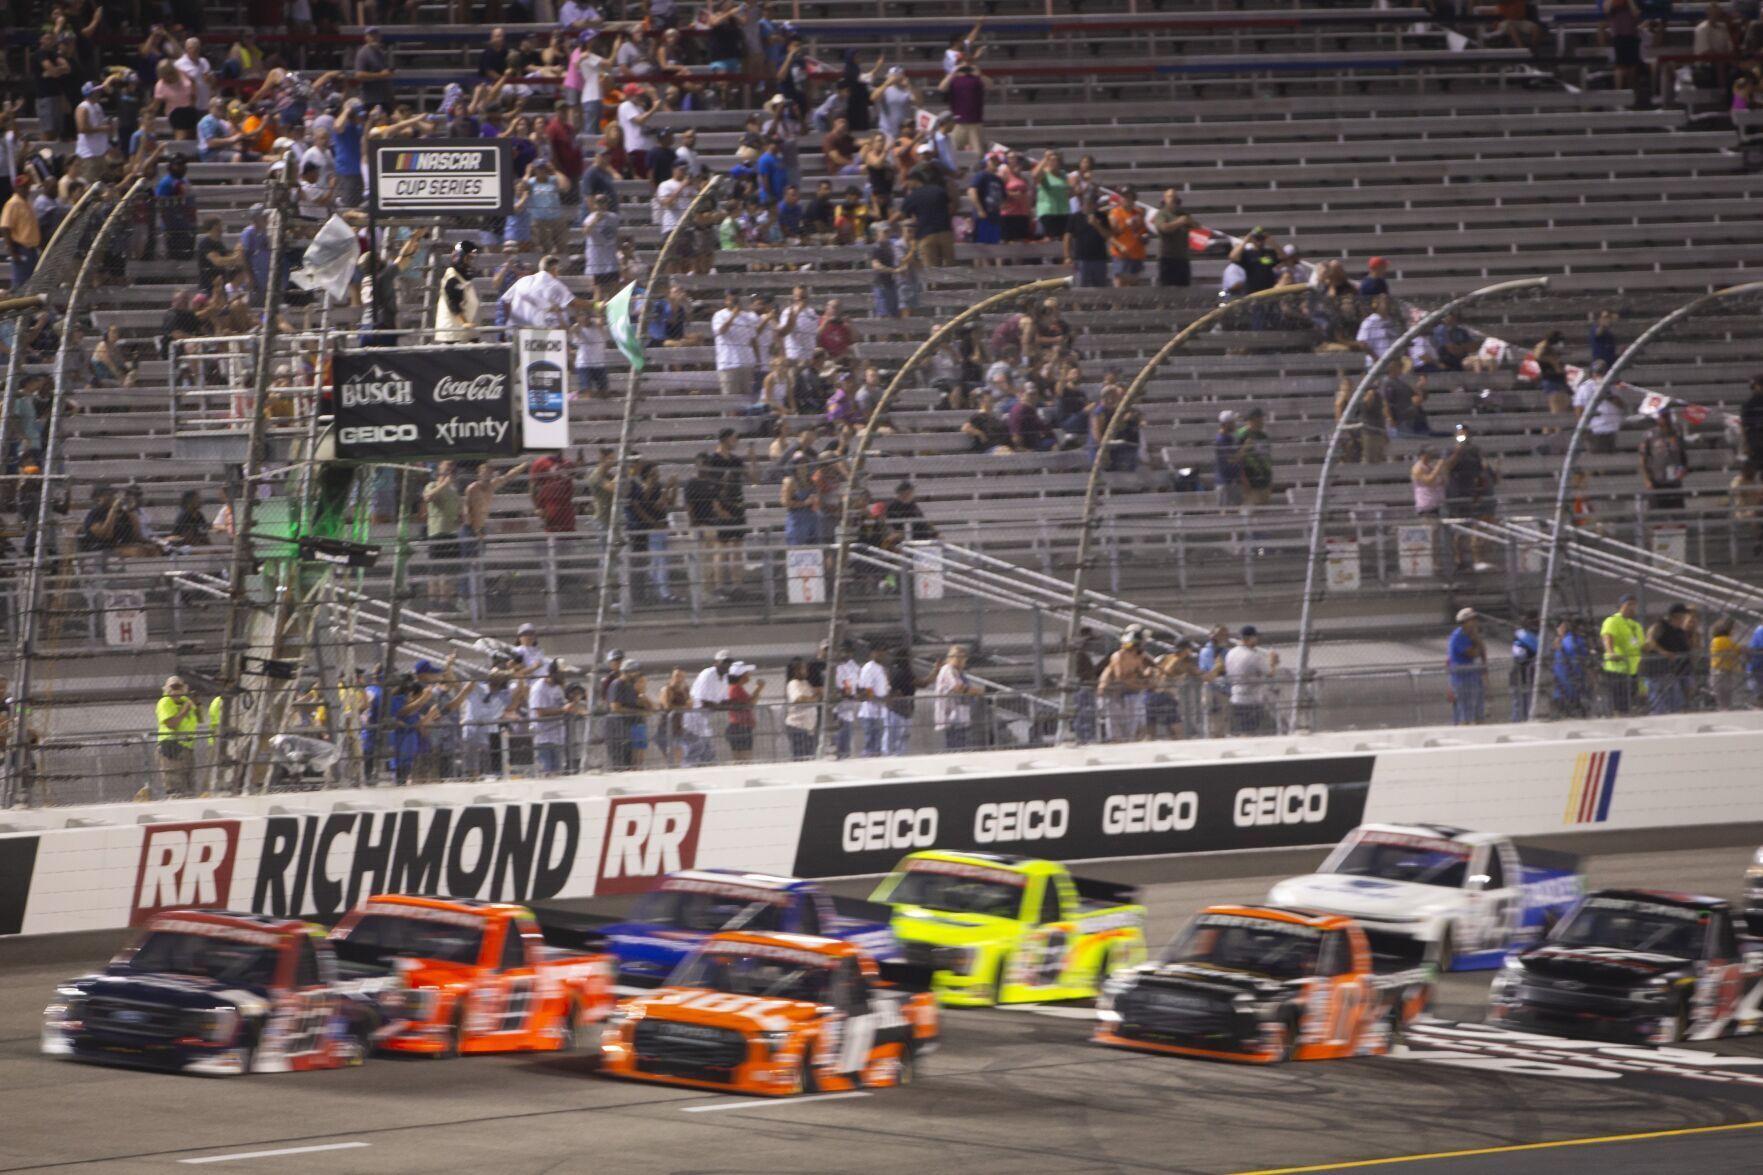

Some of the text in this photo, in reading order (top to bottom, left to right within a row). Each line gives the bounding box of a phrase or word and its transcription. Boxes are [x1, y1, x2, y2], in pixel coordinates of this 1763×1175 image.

[416, 152, 482, 170] NASCAR
[396, 179, 482, 195] CUP SERIES
[341, 380, 415, 407] BUSCH
[339, 424, 418, 444] GEICO
[435, 416, 509, 445] xfinity
[120, 622, 133, 642] H
[842, 783, 1328, 852] GEICO GEICO GEICO GEICO
[251, 801, 581, 918] RICHMOND
